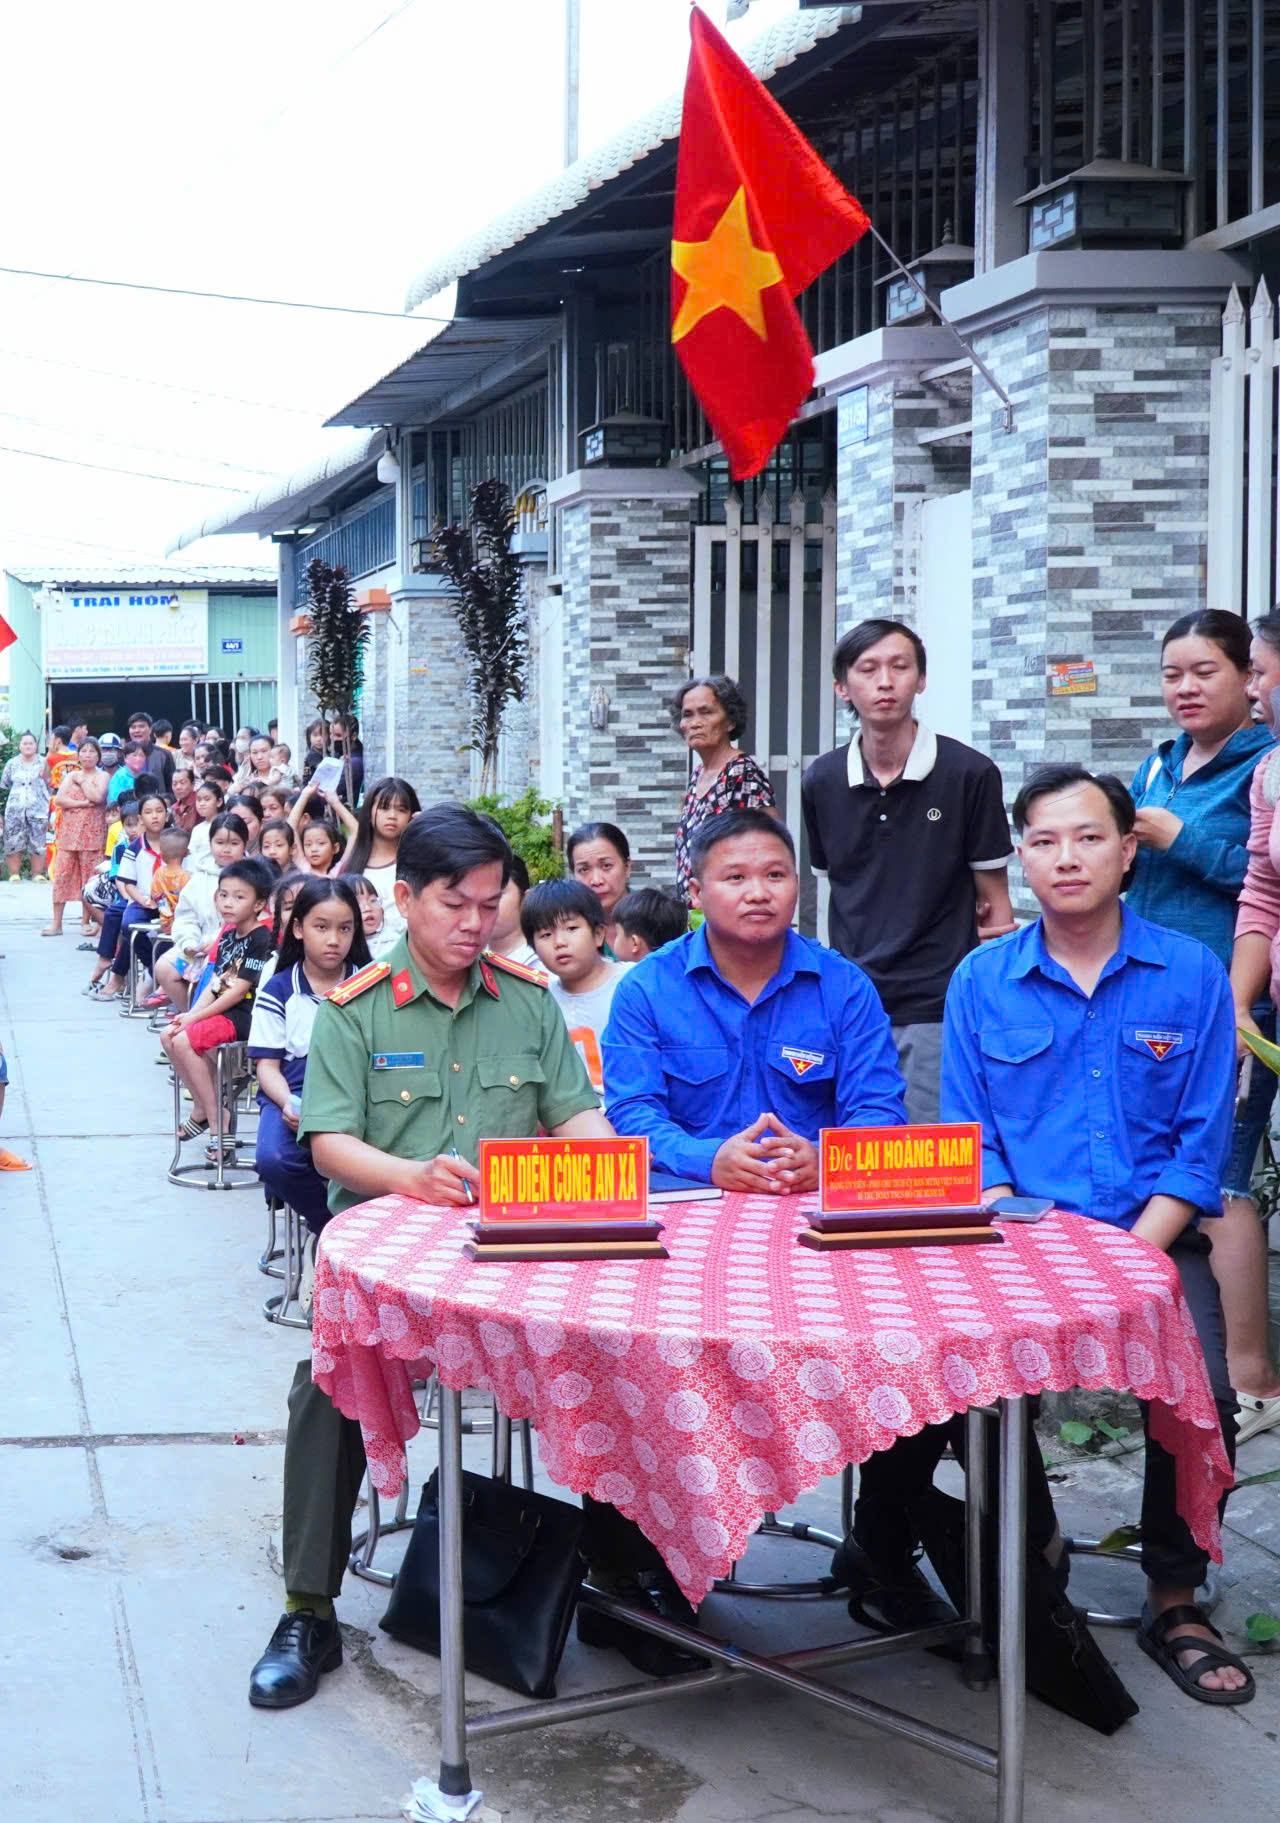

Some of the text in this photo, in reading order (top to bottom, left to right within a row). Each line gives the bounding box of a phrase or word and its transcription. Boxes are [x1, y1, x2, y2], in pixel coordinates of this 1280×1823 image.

[489, 1143, 637, 1214] ĐẠI DIỆN CÔNG AN XÃ
[829, 1134, 973, 1177] Đ/c LẠI HOÀNG NAM
